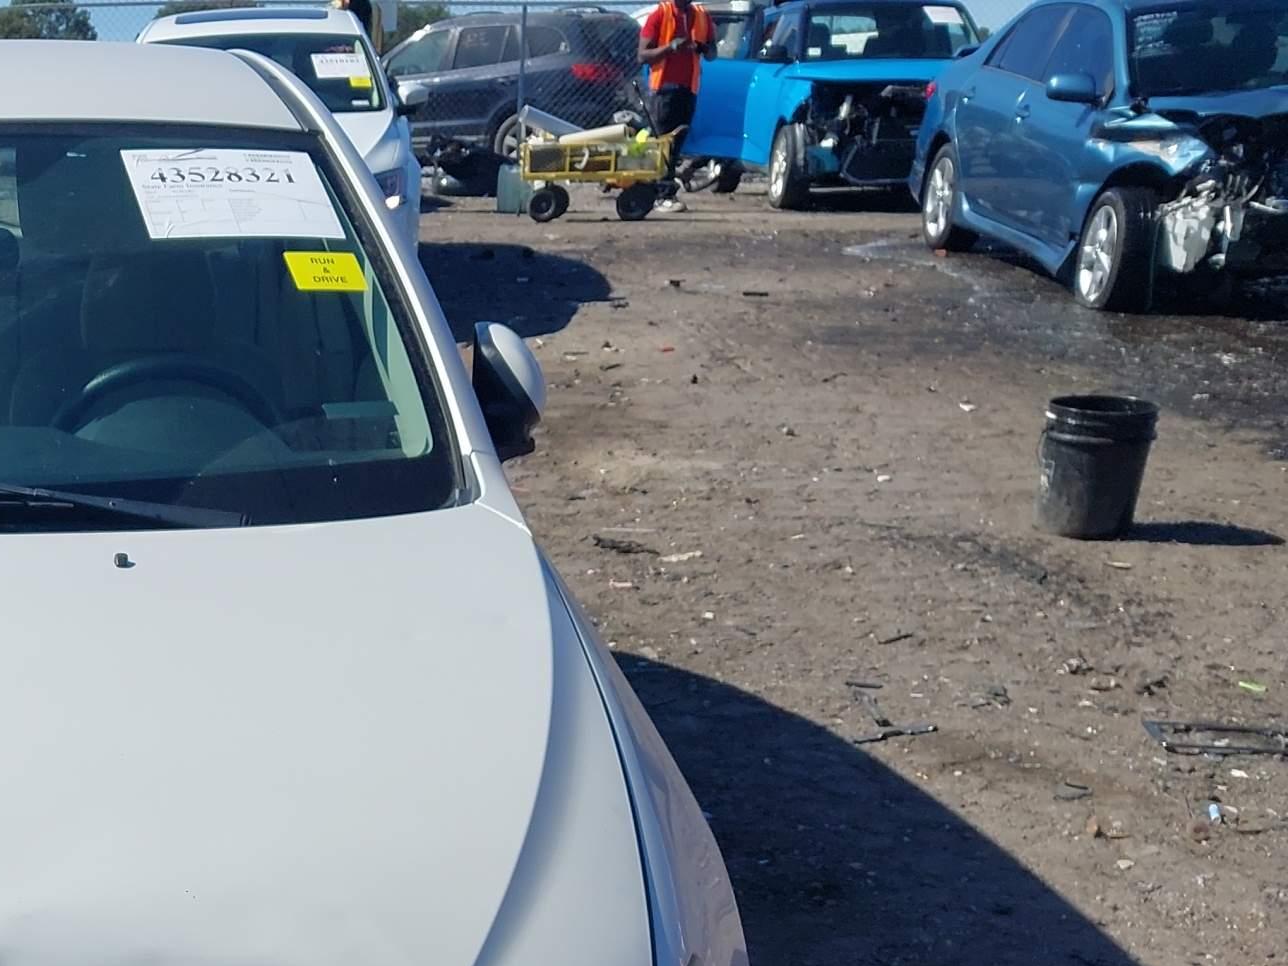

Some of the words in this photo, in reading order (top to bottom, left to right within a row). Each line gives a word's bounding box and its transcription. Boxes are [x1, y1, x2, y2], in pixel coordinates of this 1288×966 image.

[150, 166, 296, 184] 43528321
[310, 256, 335, 265] RUN
[322, 266, 331, 274] &
[312, 275, 349, 284] DRIVE
